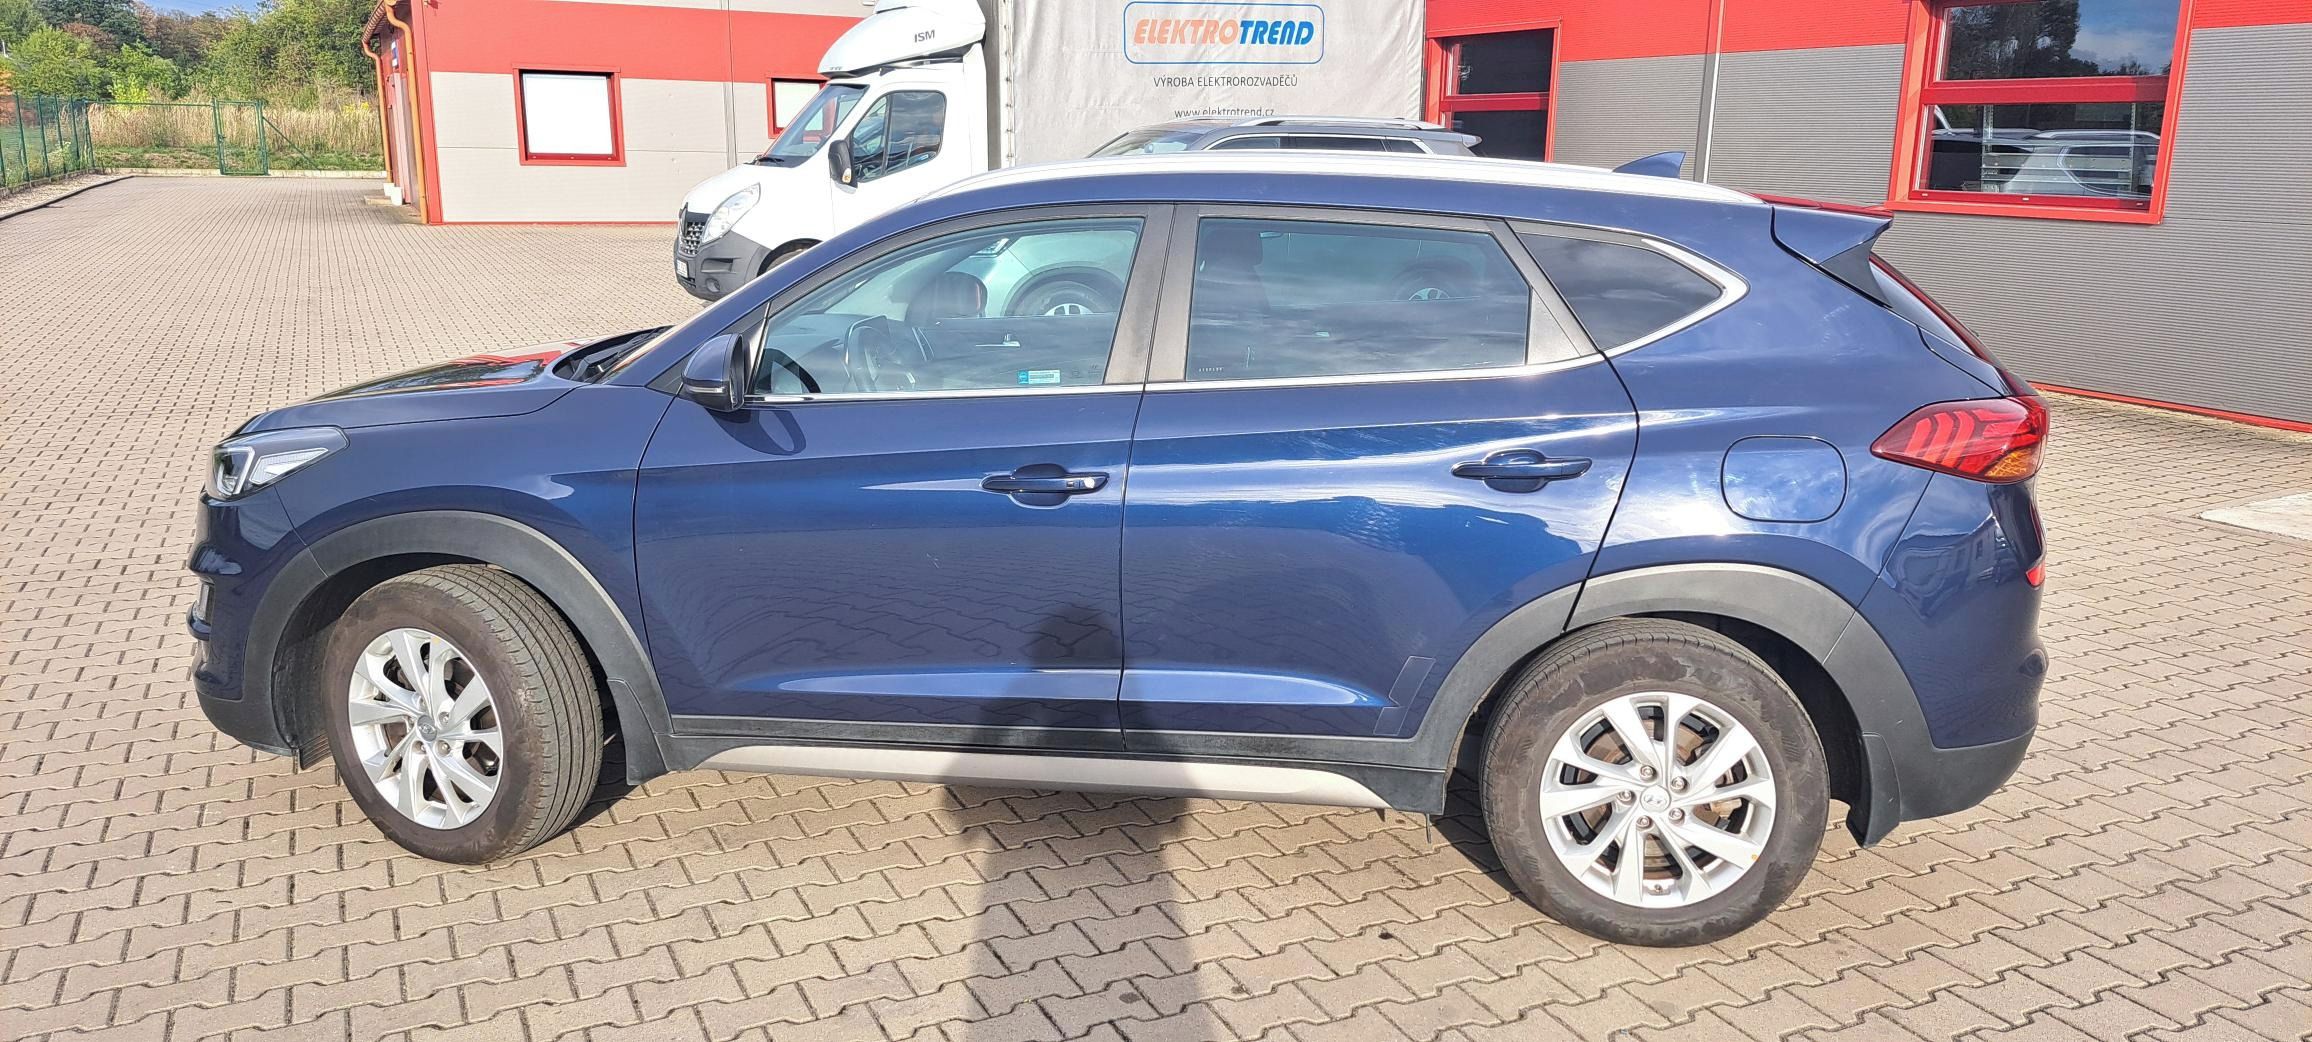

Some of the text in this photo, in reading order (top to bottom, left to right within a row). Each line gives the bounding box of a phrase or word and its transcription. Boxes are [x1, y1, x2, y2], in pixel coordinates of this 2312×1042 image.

[914, 29, 935, 43] ISM
[1133, 18, 1315, 46] ELEKTROTREND
[1153, 73, 1298, 88] VÝROBA ELEKTROROZVADĚČŮ
[1174, 106, 1275, 118] wwwelektrotrend.cz
